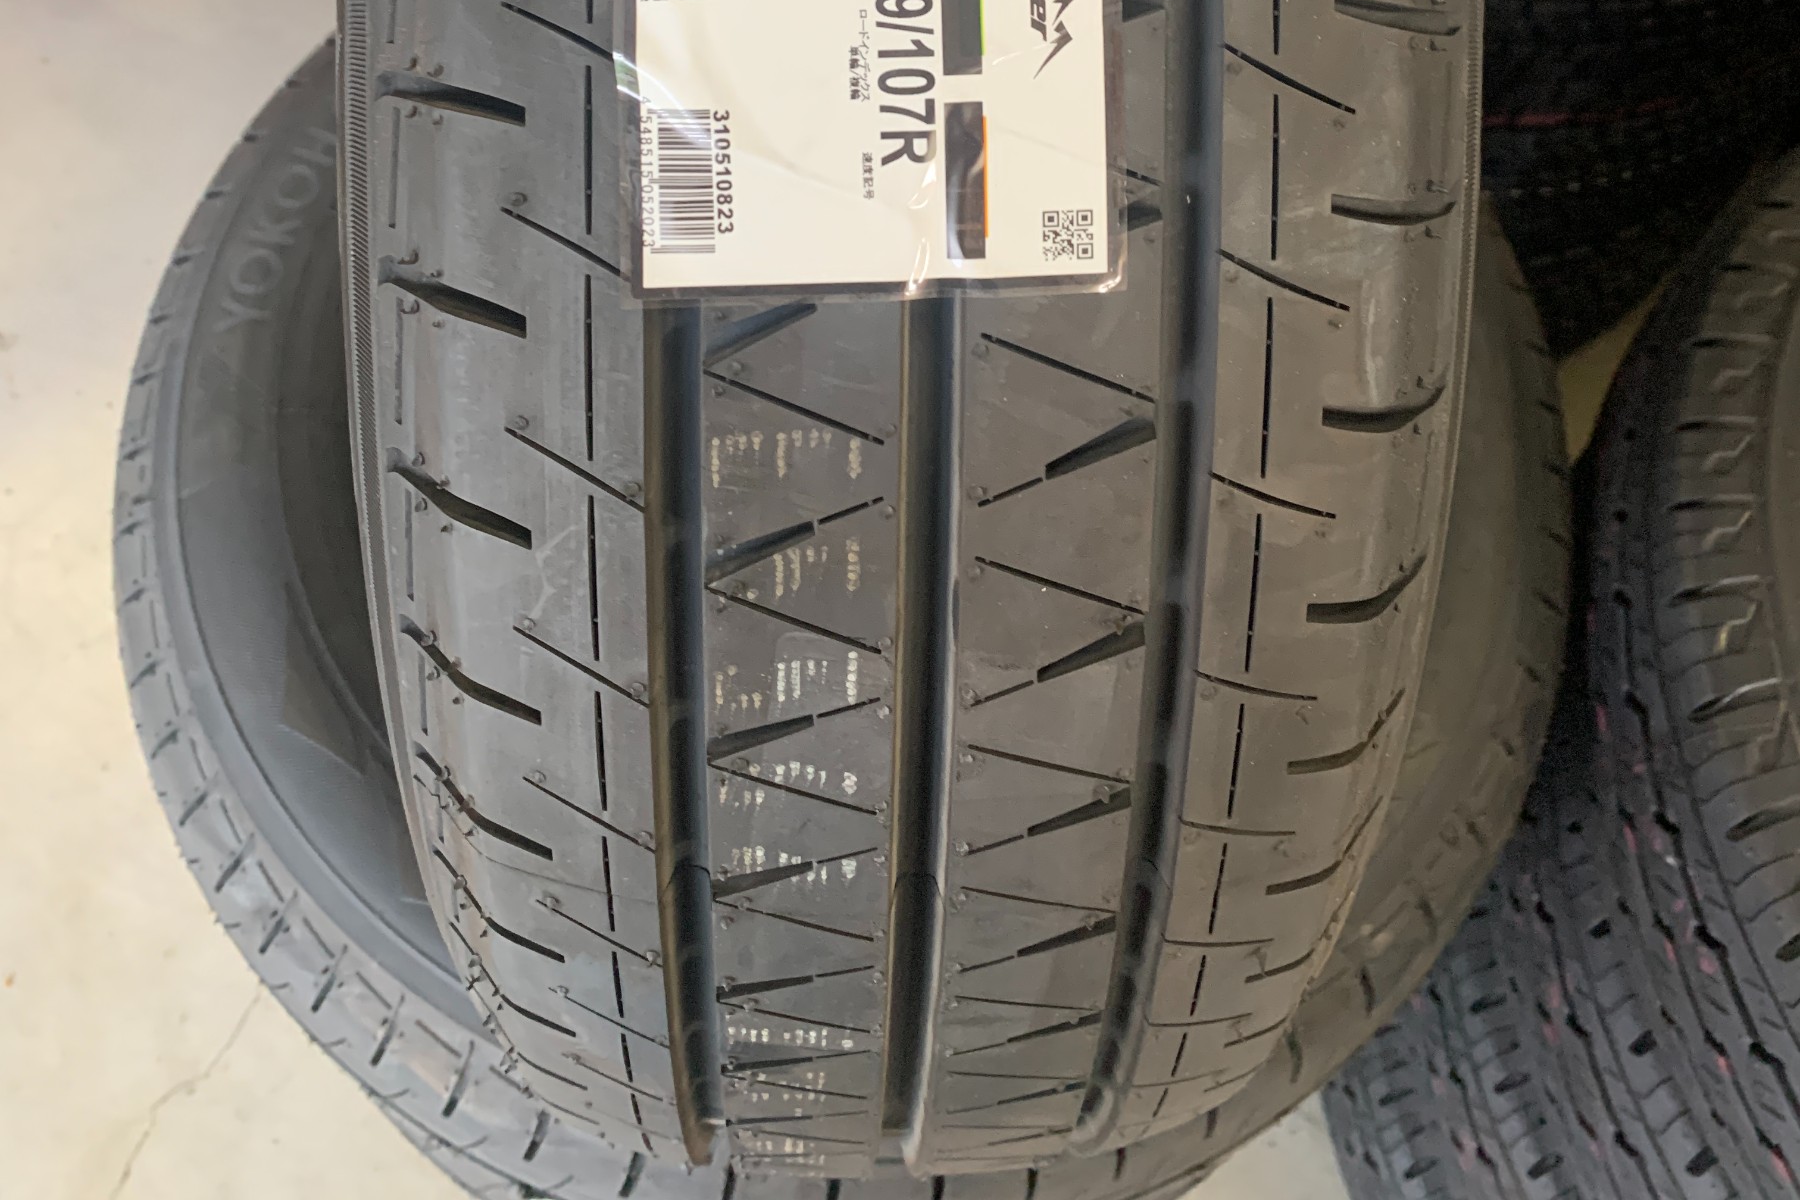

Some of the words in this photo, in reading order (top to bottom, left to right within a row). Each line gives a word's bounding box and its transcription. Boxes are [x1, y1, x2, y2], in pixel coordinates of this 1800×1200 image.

[858, 9, 871, 102] ロードインデックス
[640, 116, 653, 179] 548515
[713, 109, 734, 234] 310510823
[862, 152, 874, 200] 速度記号
[641, 185, 655, 248] 052023
